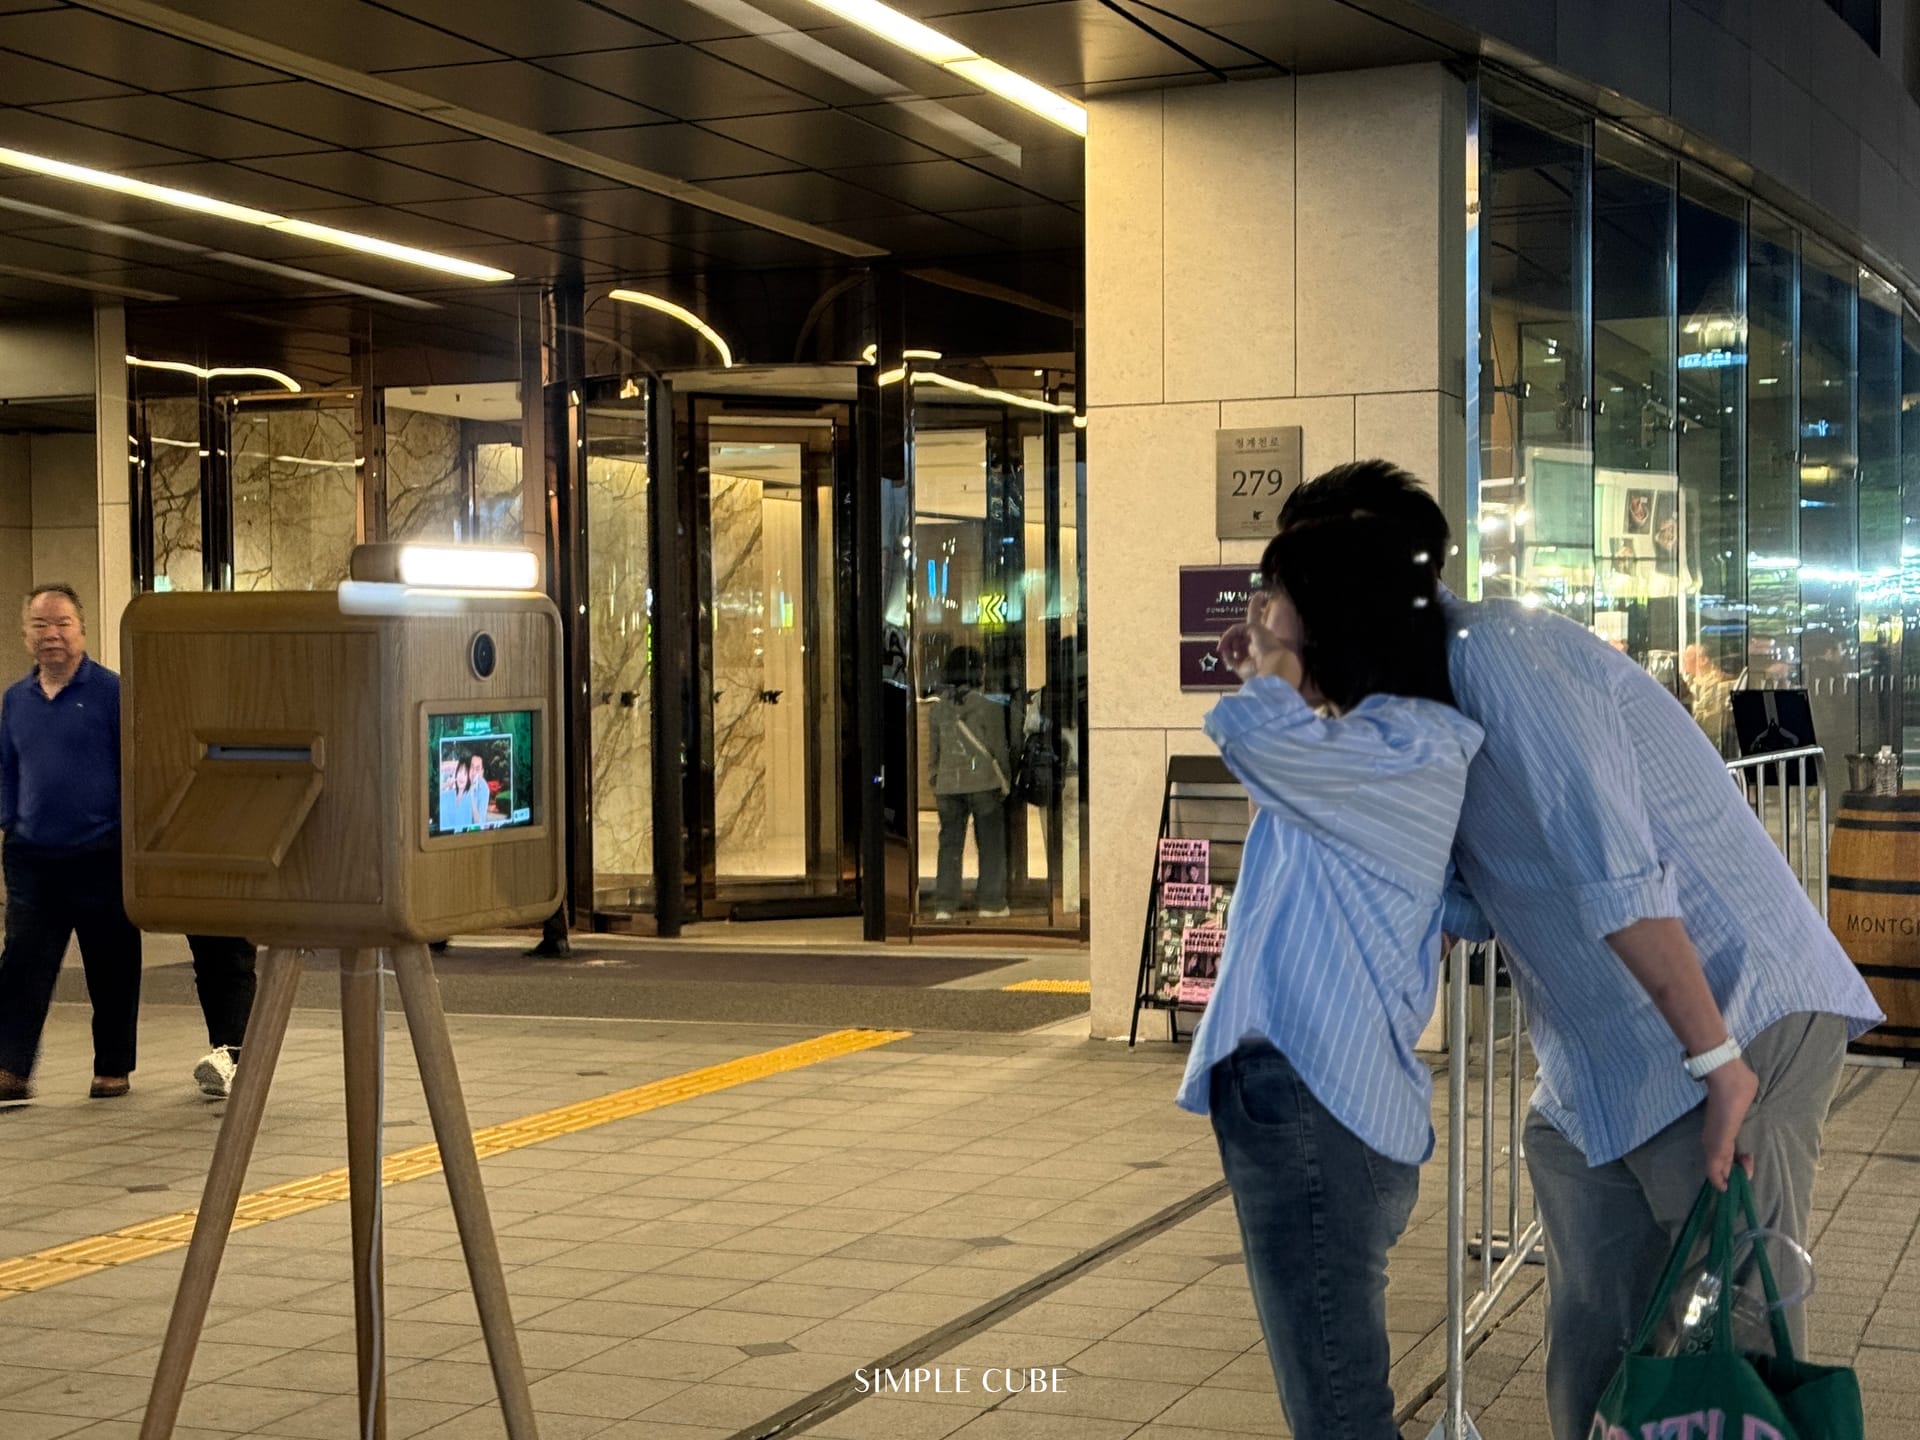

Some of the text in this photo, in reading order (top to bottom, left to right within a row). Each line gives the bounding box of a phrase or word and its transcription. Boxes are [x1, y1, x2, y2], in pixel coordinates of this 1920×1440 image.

[1232, 469, 1283, 497] 279
[1216, 591, 1236, 602] JW
[1846, 914, 1920, 936] MONTG
